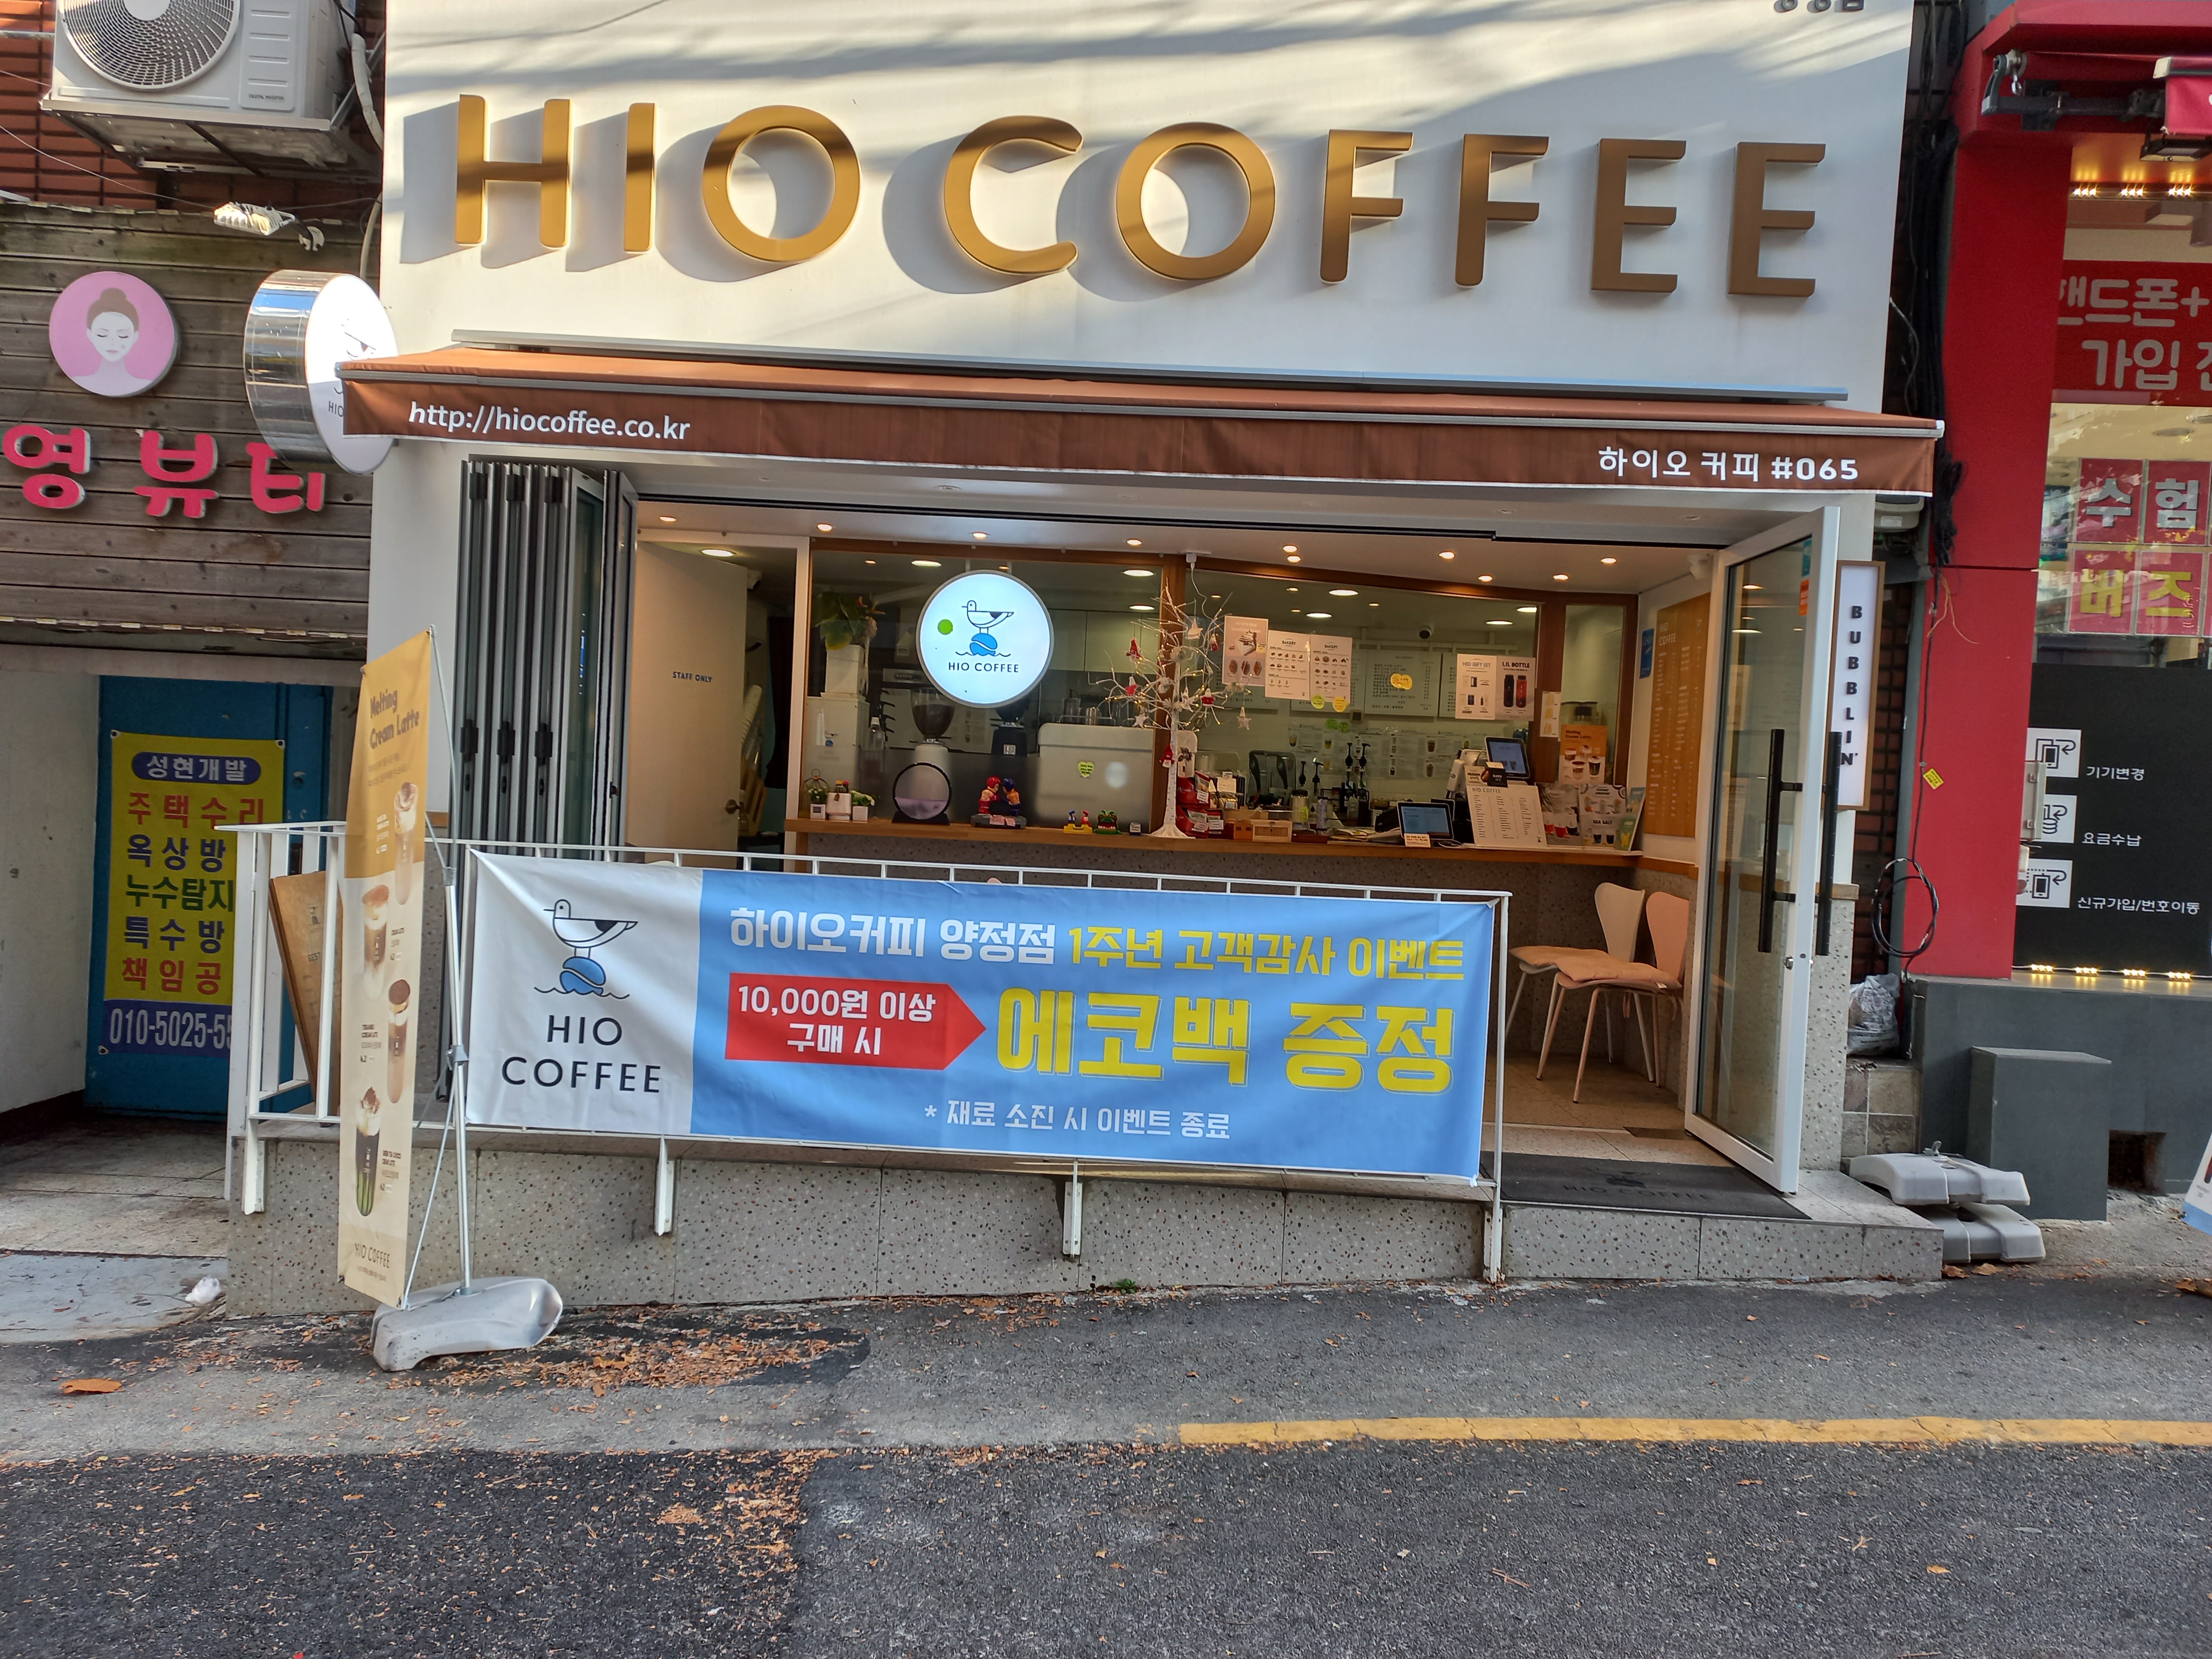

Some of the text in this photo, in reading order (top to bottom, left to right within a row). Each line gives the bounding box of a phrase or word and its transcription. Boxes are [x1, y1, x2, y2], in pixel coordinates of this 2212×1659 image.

[454, 93, 1826, 297] HIO COFFEE
[2082, 339, 2180, 390] 가입
[408, 401, 690, 440] http://hiocoffee.co.kr
[1598, 446, 1858, 482] 하이오 커피 #065
[673, 671, 712, 683] STAFF ONLY
[948, 662, 1019, 673] HIO COFFEE
[370, 688, 398, 719] Melting
[370, 709, 419, 749] Cream Latte
[2086, 766, 2145, 781] 기기변경
[128, 791, 263, 830] 주택수리
[127, 833, 226, 872] 옥상방
[2082, 832, 2142, 847] 요금수납
[2077, 896, 2201, 915] 신규가입/번호이동
[124, 916, 224, 953] 특수방
[730, 907, 1464, 980] 하이오커피 양정점 1주년 고객감사 이벤트
[122, 958, 221, 995] 책임공
[738, 985, 936, 1022] 10,000원 이상
[547, 1015, 622, 1045] HIO
[786, 1022, 882, 1055] 구매 시
[997, 987, 1455, 1095] 에코백 증정
[502, 1056, 661, 1093] COFFEE
[947, 1100, 1230, 1139] 재료 소진 시 이벤트 종료
[368, 1247, 390, 1268] COFFEE
